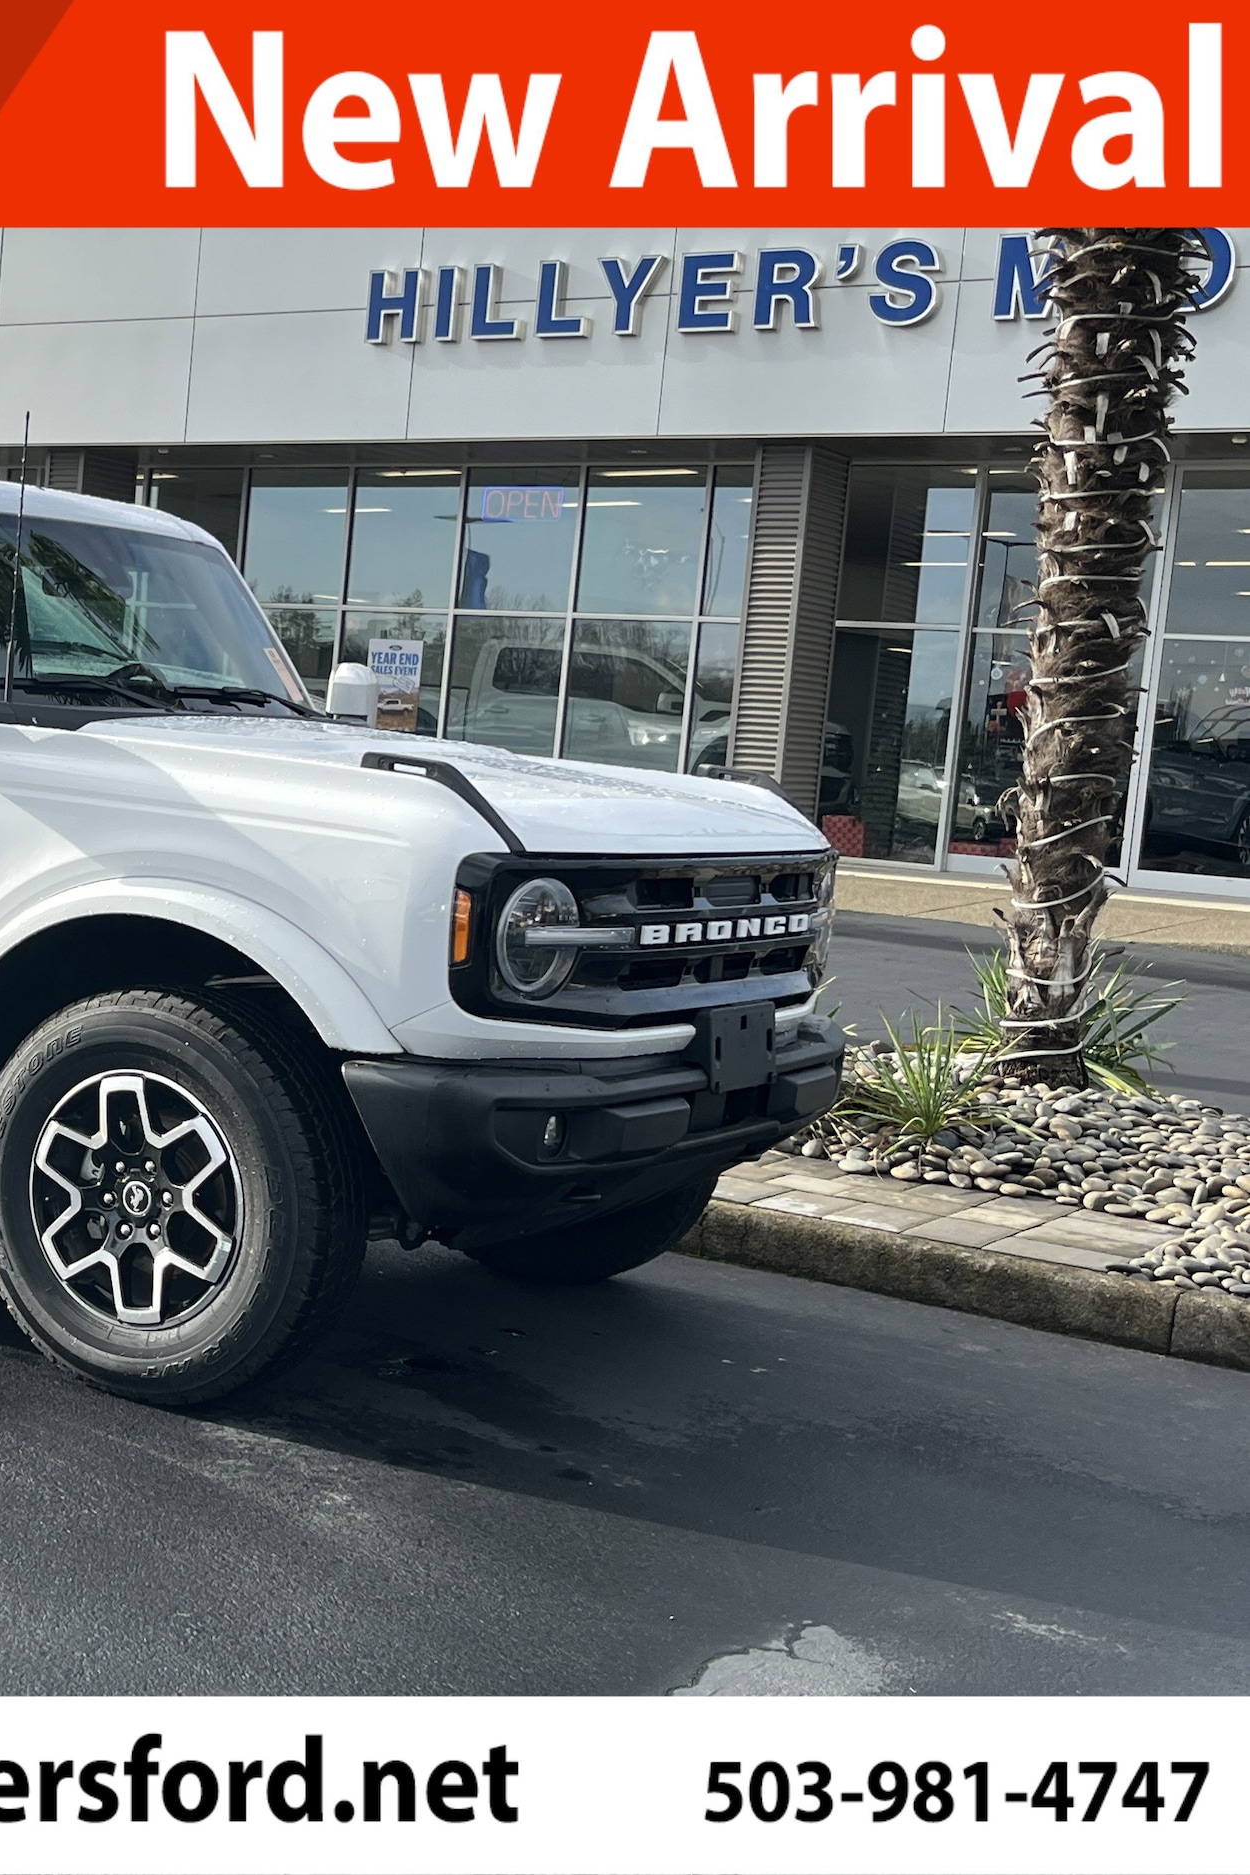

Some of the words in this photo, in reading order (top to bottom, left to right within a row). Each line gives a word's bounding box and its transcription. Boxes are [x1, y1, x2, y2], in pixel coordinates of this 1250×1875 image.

[364, 238, 943, 345] HILLYER'S
[485, 489, 562, 519] OPEN
[371, 652, 397, 665] YEAR
[399, 653, 419, 666] END
[371, 665, 393, 675] SALES
[395, 666, 418, 676] EVENT
[639, 912, 809, 946] BRONCO
